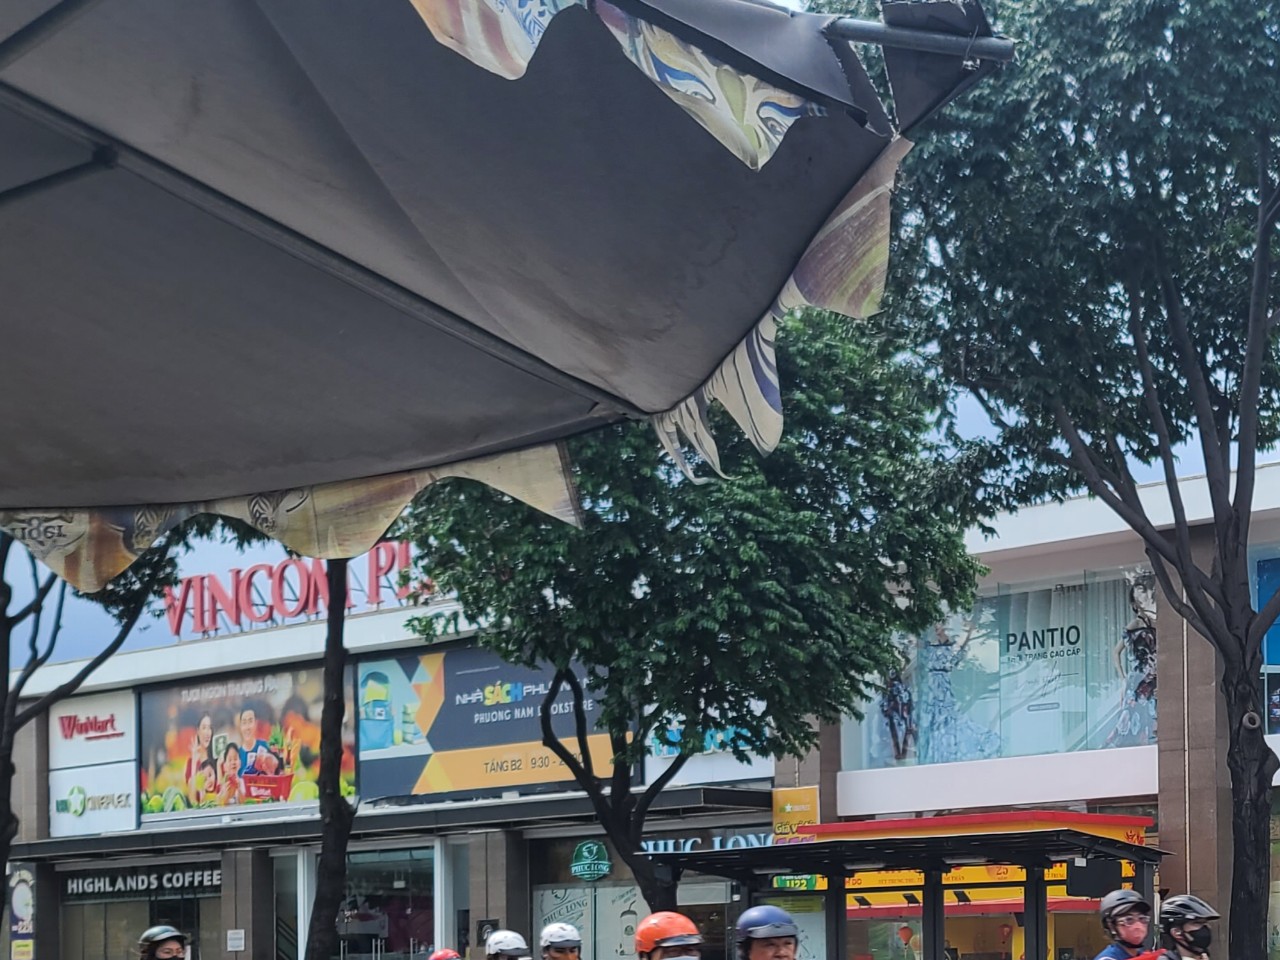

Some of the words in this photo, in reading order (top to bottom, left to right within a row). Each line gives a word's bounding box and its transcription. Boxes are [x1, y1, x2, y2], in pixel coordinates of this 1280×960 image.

[1006, 625, 1081, 652] PANTIO
[1050, 649, 1065, 660] CAO
[484, 680, 524, 707] SÁCH
[514, 706, 534, 720] NAM
[510, 758, 522, 771] B2
[67, 873, 158, 895] HIGHLANDS
[162, 869, 222, 888] COFFEE
